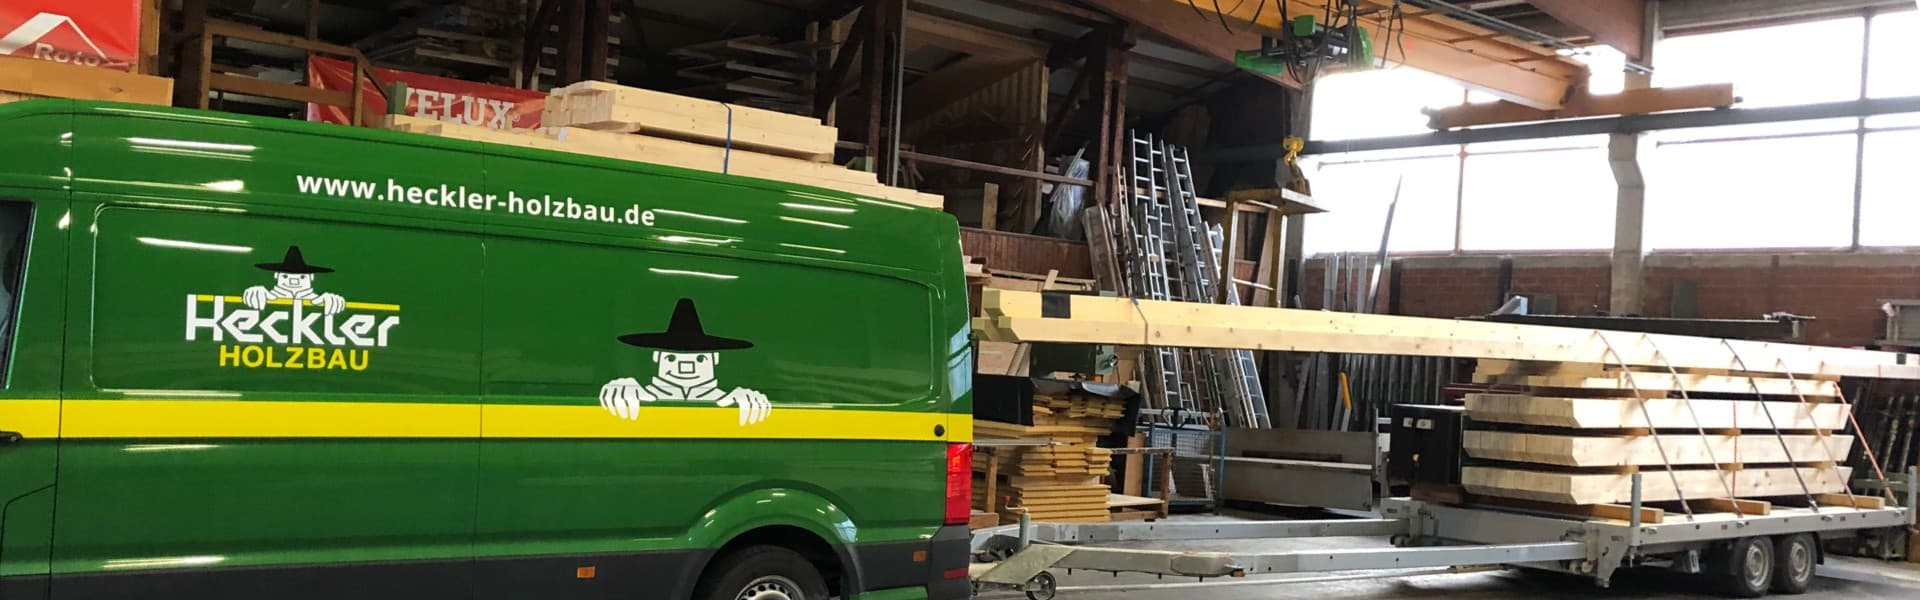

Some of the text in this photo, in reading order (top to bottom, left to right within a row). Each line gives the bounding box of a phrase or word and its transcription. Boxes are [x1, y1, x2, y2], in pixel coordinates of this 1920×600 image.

[33, 42, 101, 67] Roto
[296, 174, 656, 227] www.heckler-holzbau.de
[185, 294, 400, 347] Heckler
[219, 344, 369, 371] HOLZBAU
